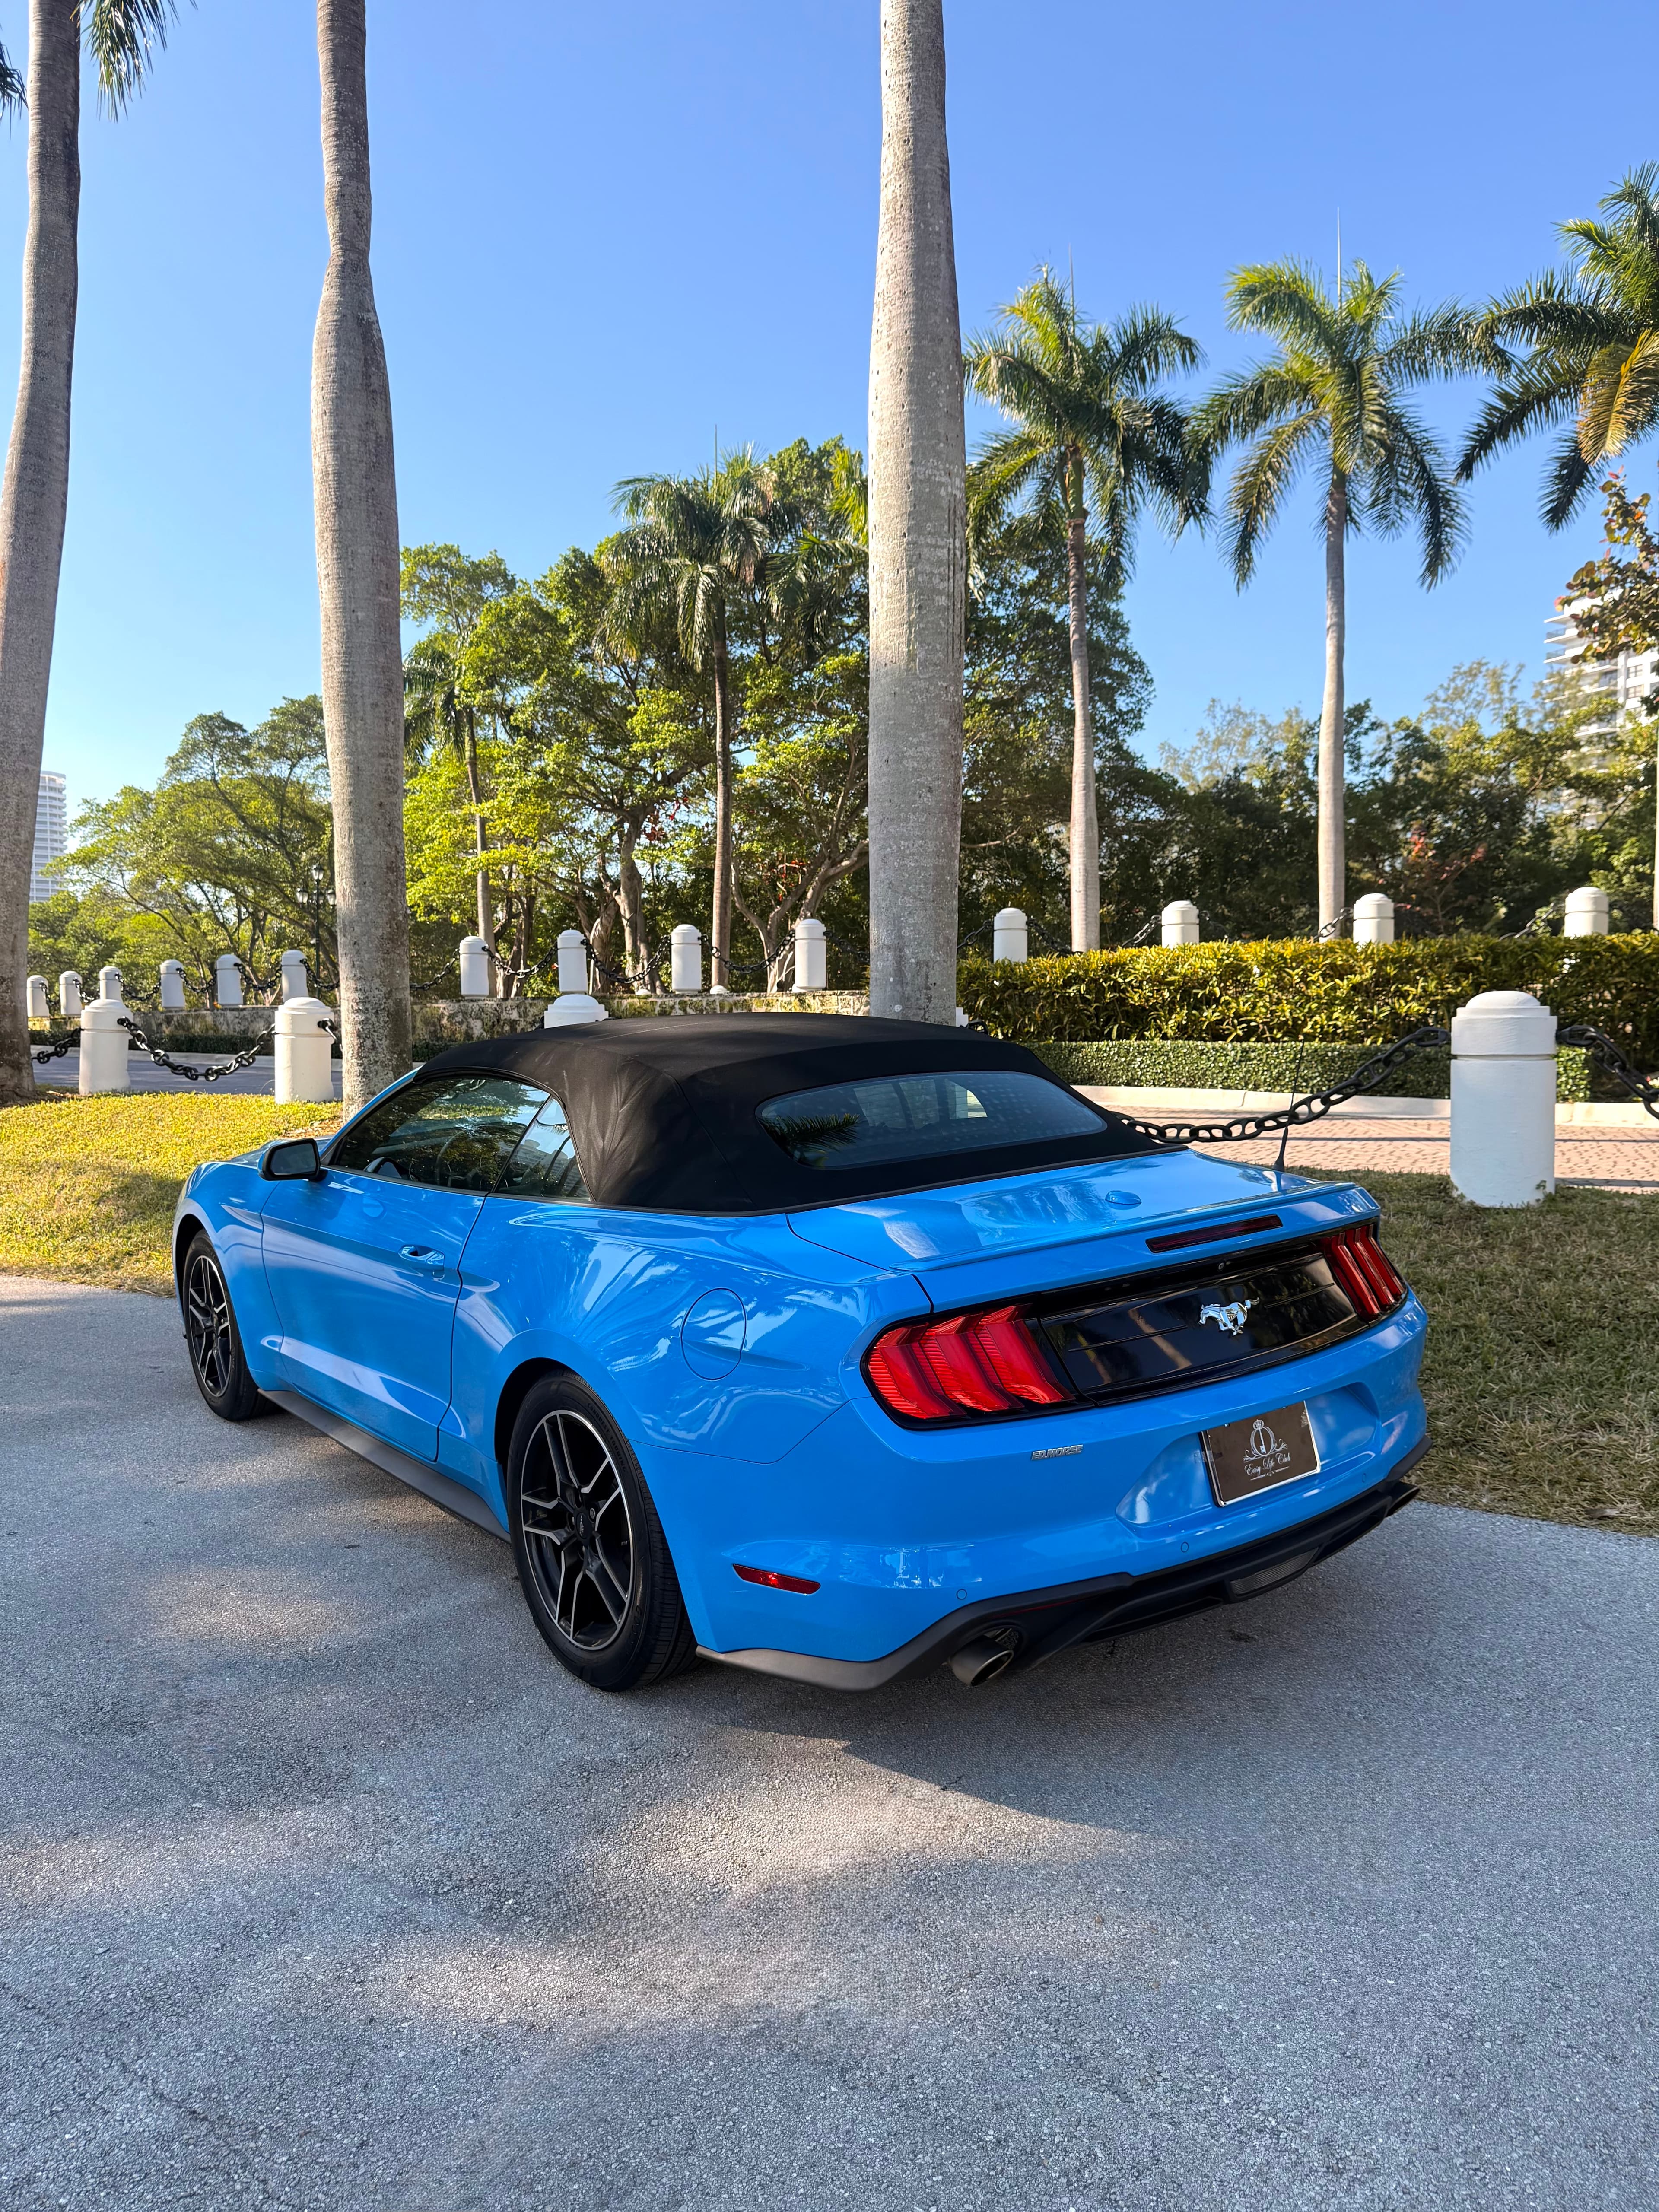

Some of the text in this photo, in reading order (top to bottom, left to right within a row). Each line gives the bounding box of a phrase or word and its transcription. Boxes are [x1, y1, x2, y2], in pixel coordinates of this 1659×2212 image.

[1244, 1452, 1291, 1476] Easy Life Club
